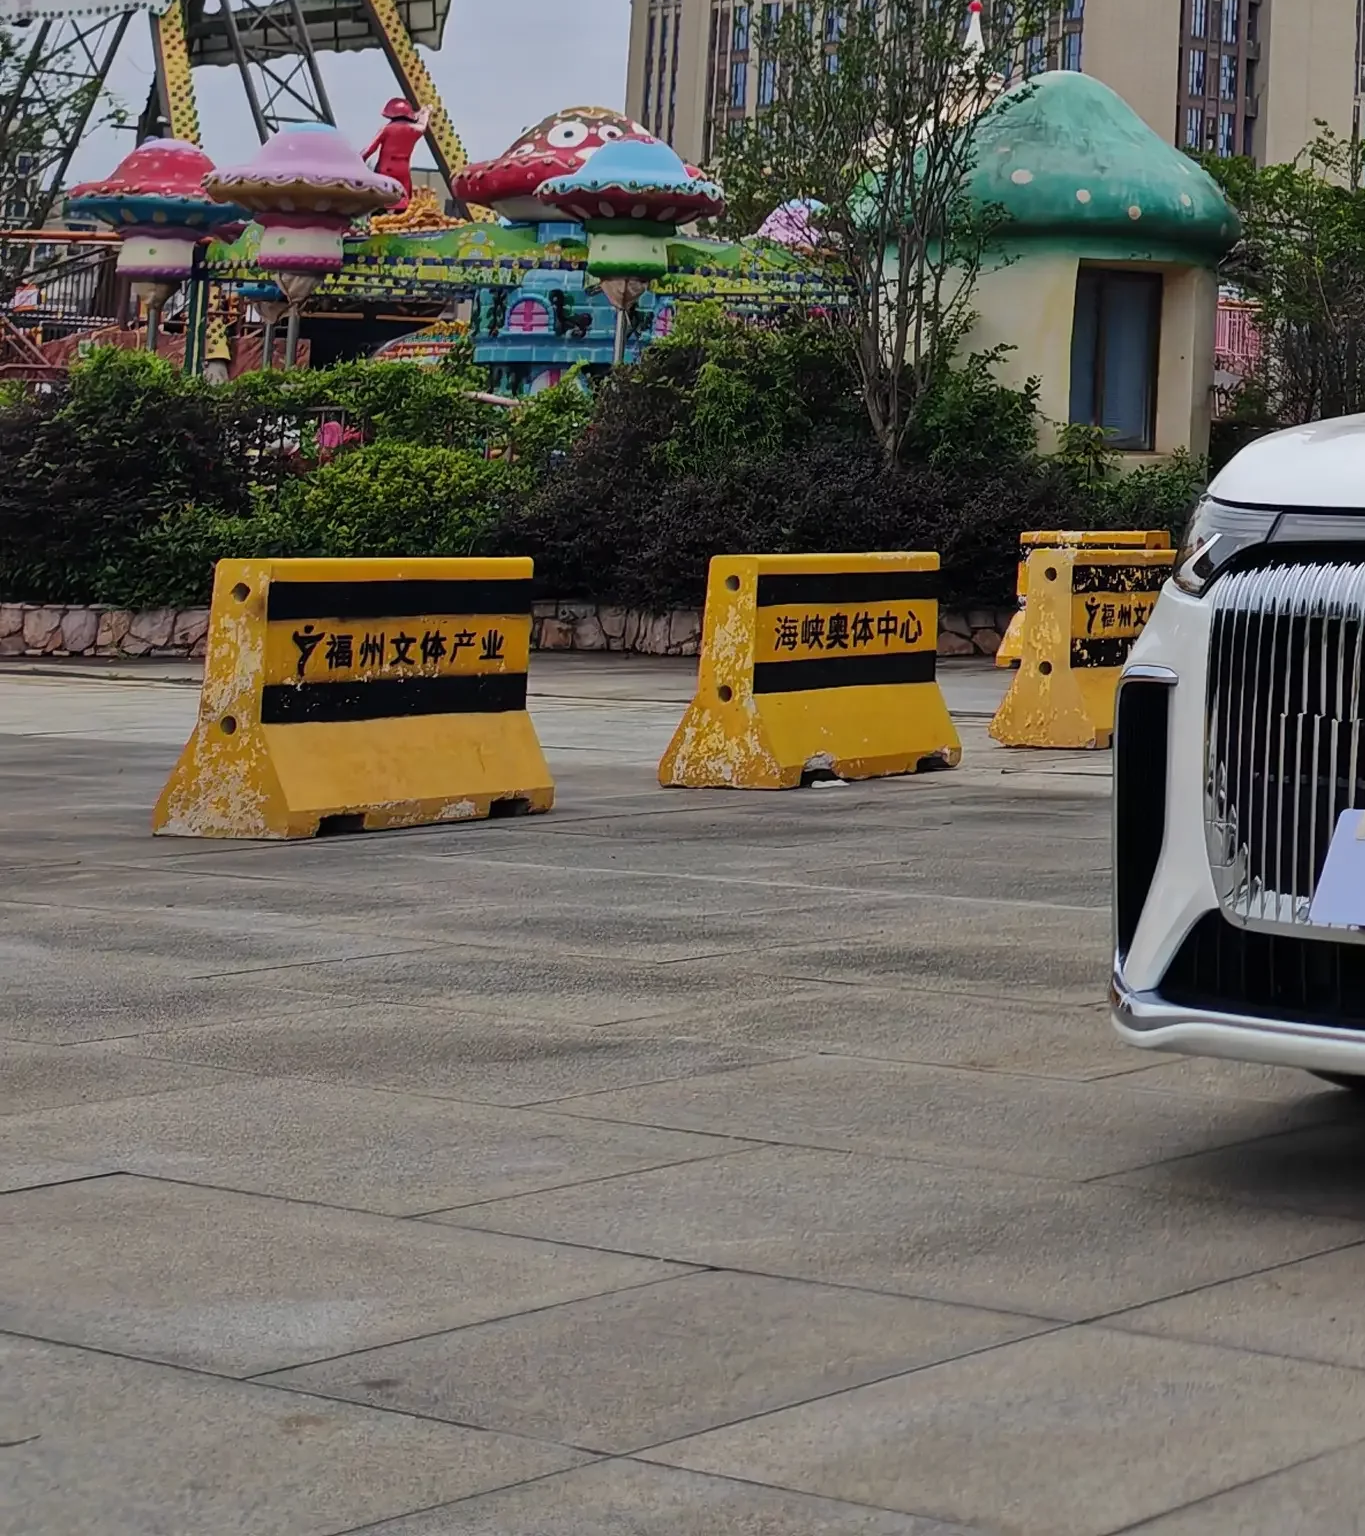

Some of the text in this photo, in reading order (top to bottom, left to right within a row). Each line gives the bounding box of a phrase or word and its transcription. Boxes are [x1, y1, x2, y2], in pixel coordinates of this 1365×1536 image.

[774, 610, 923, 651] 海峡奥体中心
[1101, 602, 1156, 629] 福州文
[325, 628, 505, 671] 福州文体产业
